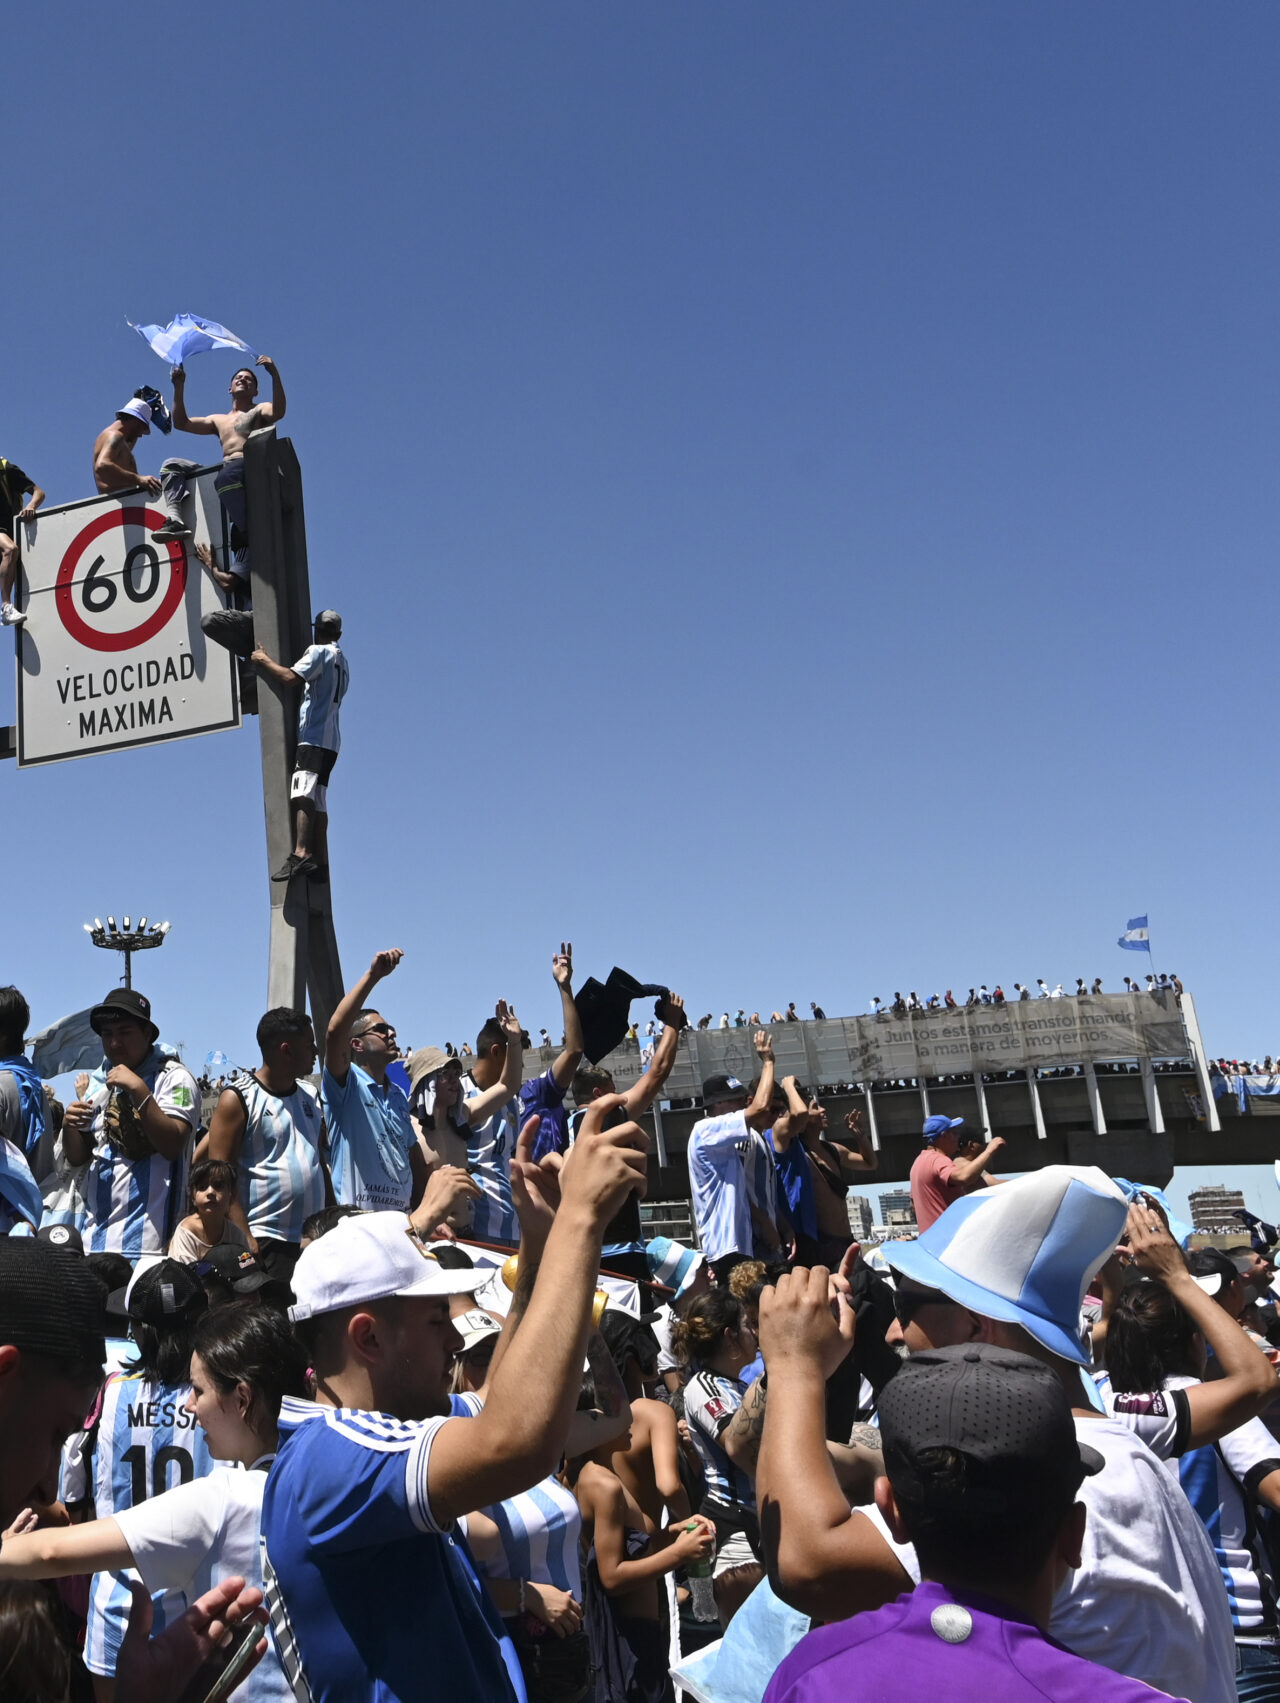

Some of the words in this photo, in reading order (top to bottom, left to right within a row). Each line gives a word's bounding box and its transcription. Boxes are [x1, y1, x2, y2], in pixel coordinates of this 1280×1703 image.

[82, 543, 160, 613] 60
[56, 652, 195, 704] VELOCIDAD
[79, 695, 174, 739] MAXIMA
[885, 1027, 938, 1043] Juntos
[942, 1021, 1010, 1038] estamos
[915, 1044, 930, 1057] la
[935, 1042, 996, 1056] manera
[1000, 1036, 1020, 1049] de
